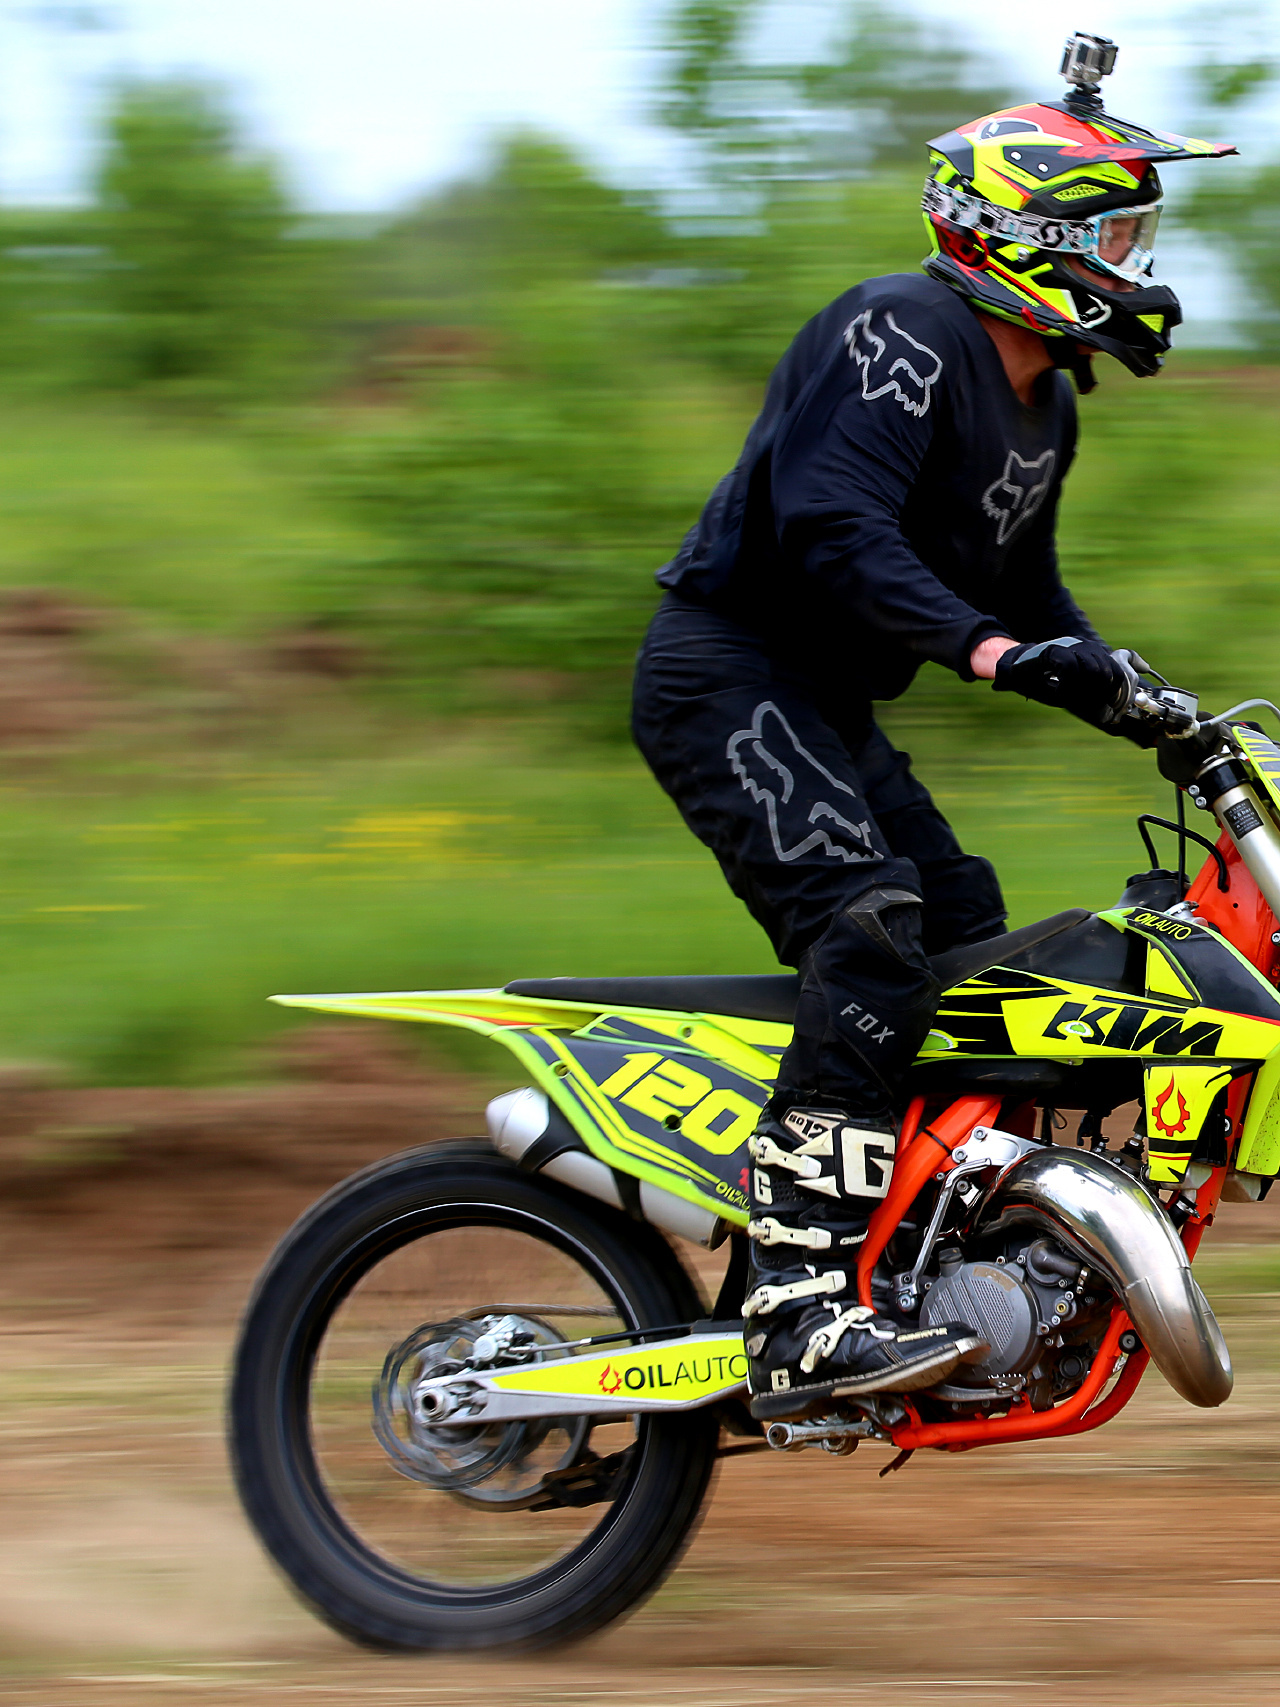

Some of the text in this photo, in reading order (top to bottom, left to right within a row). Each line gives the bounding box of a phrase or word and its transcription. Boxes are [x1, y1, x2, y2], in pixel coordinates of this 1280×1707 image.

[1134, 912, 1192, 940] OILAUTO
[840, 1002, 896, 1044] FOX
[1041, 995, 1224, 1056] KTM
[598, 1052, 763, 1156] 120
[841, 1127, 896, 1198] G
[754, 1168, 773, 1205] G
[624, 1354, 748, 1390] OILAUTO
[770, 1368, 790, 1391] G
